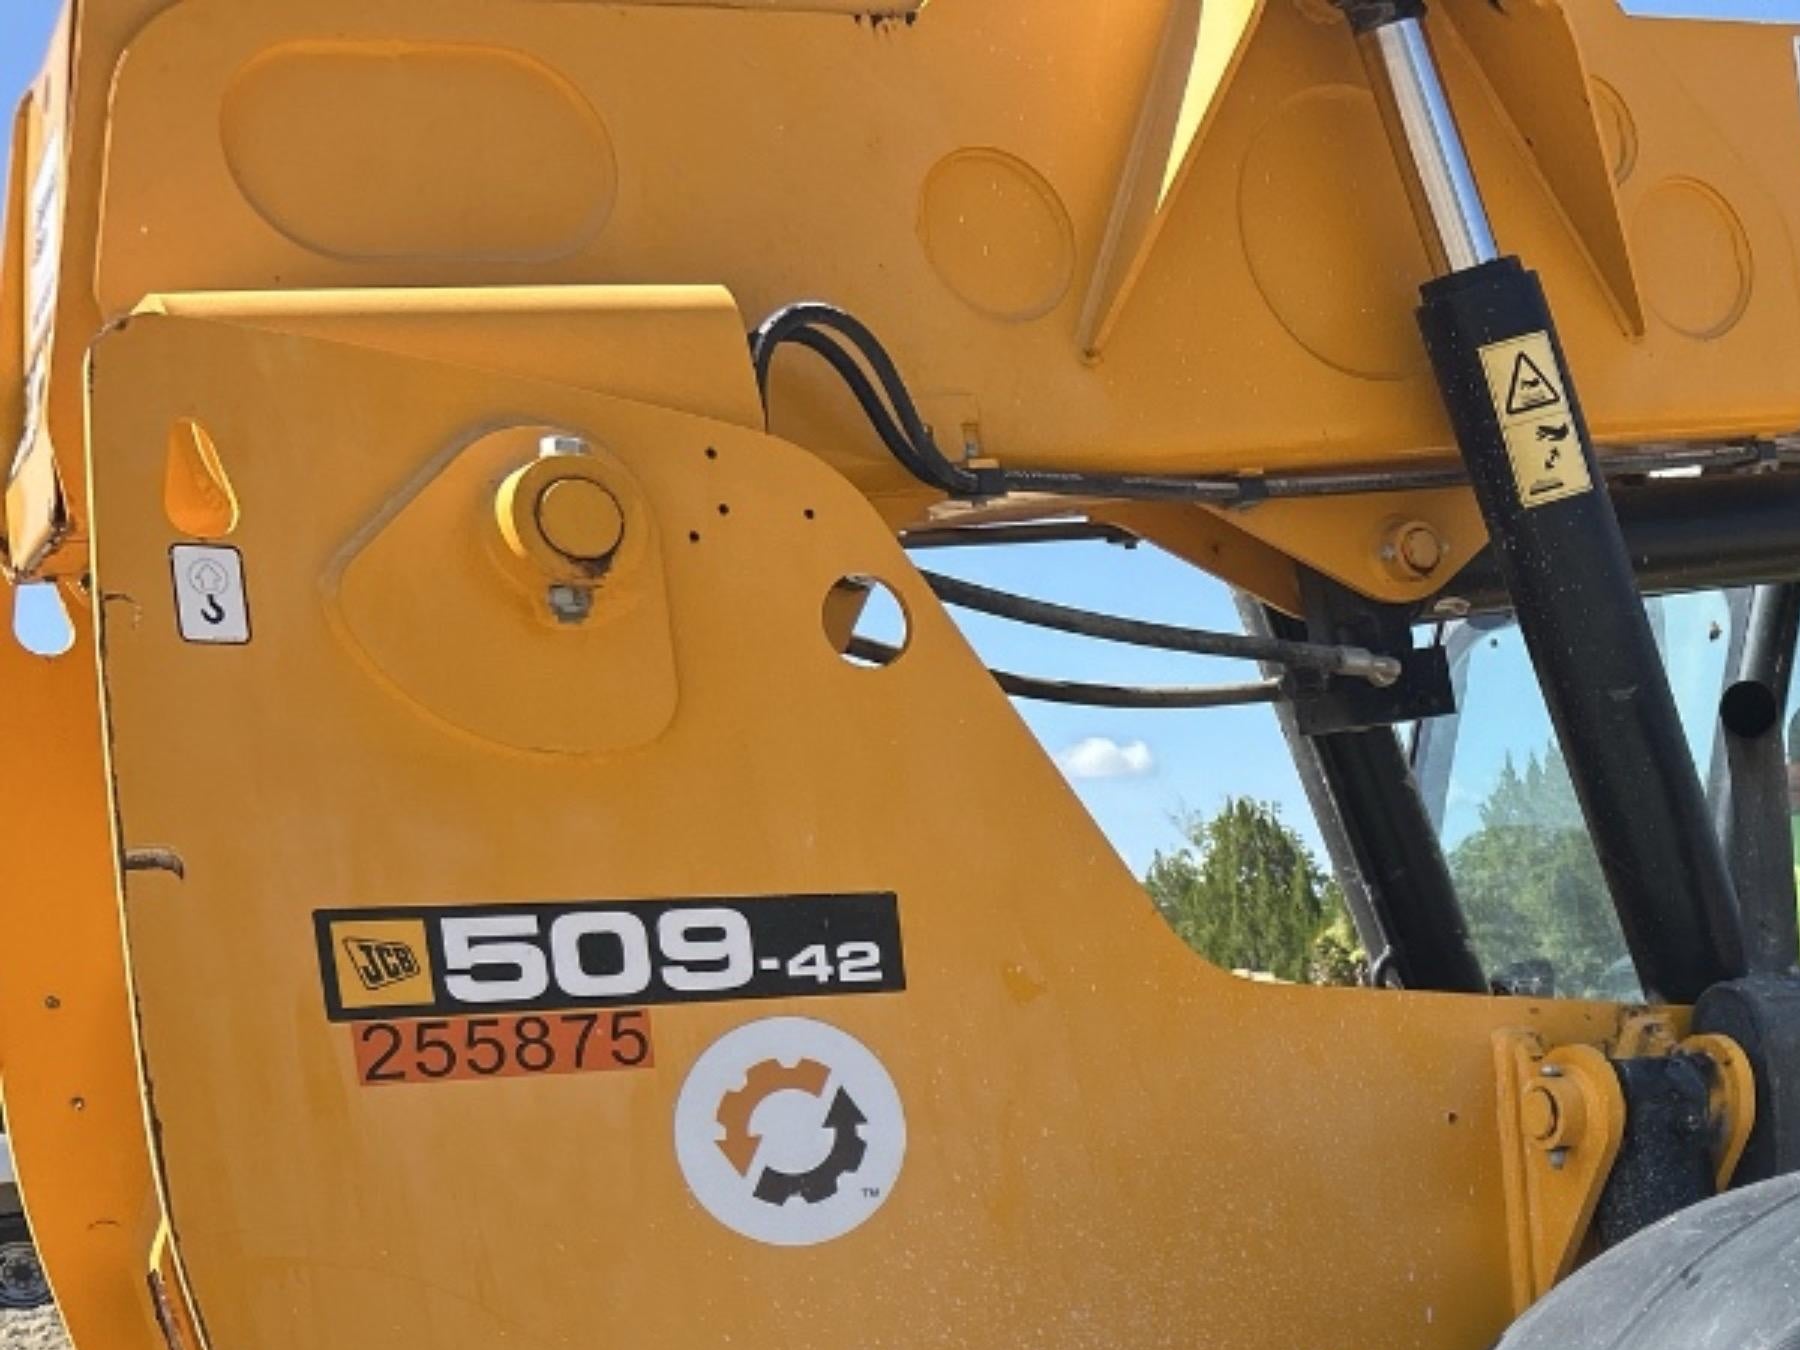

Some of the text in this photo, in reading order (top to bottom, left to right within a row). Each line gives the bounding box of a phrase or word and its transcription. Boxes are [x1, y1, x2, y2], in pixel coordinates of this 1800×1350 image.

[350, 907, 884, 1003] JCB 509-42
[360, 1010, 651, 1082] 255875
[861, 1186, 880, 1198] TM
